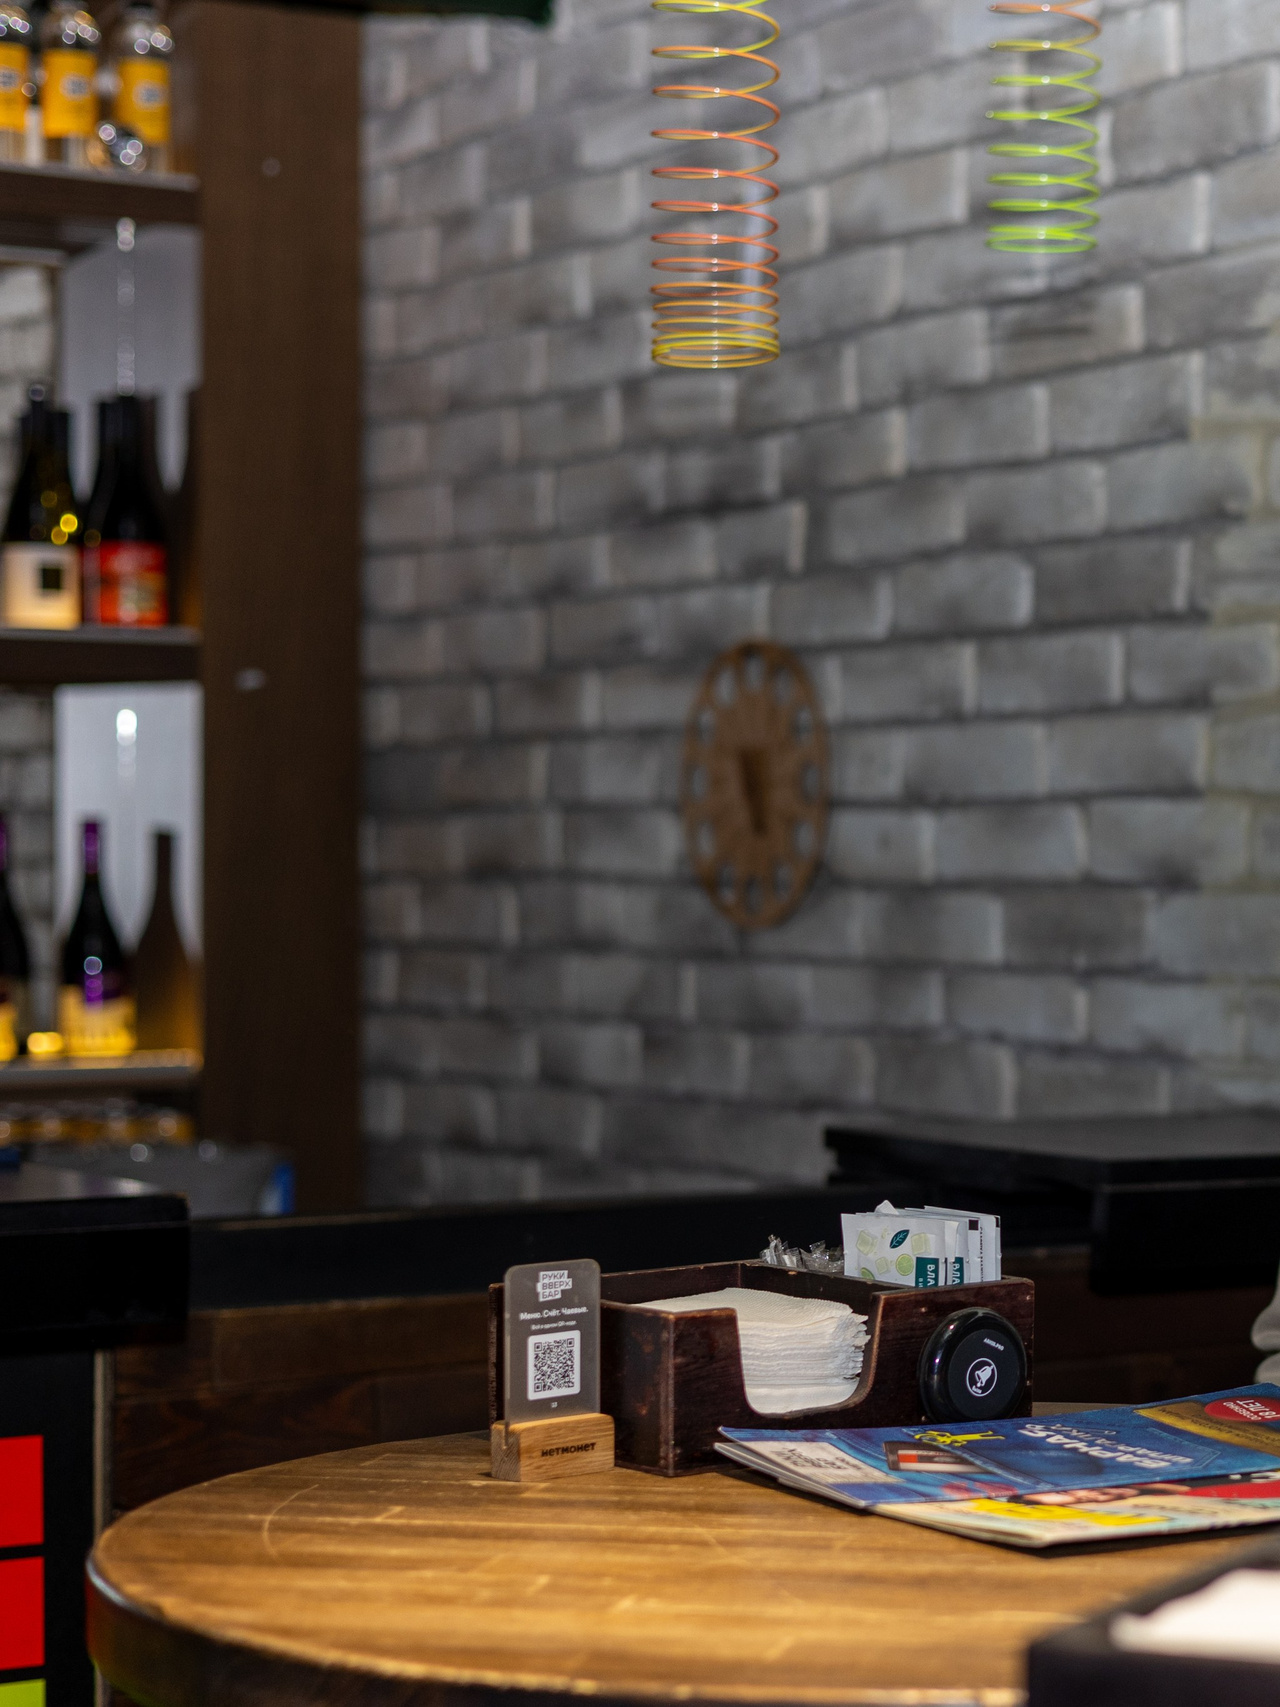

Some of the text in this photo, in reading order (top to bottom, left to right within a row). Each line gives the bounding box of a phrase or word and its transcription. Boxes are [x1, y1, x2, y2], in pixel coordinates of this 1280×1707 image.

[542, 1272, 566, 1280] РУКИ
[542, 1280, 571, 1290] ВВЕРХ
[542, 1290, 560, 1299] БАР
[1223, 1402, 1262, 1420] ОСОБЕННО
[1236, 1400, 1270, 1412] ЛЕТ
[1017, 1428, 1173, 1469] БАРНАЯ
[1049, 1424, 1194, 1463] ШПАРГАЛКА
